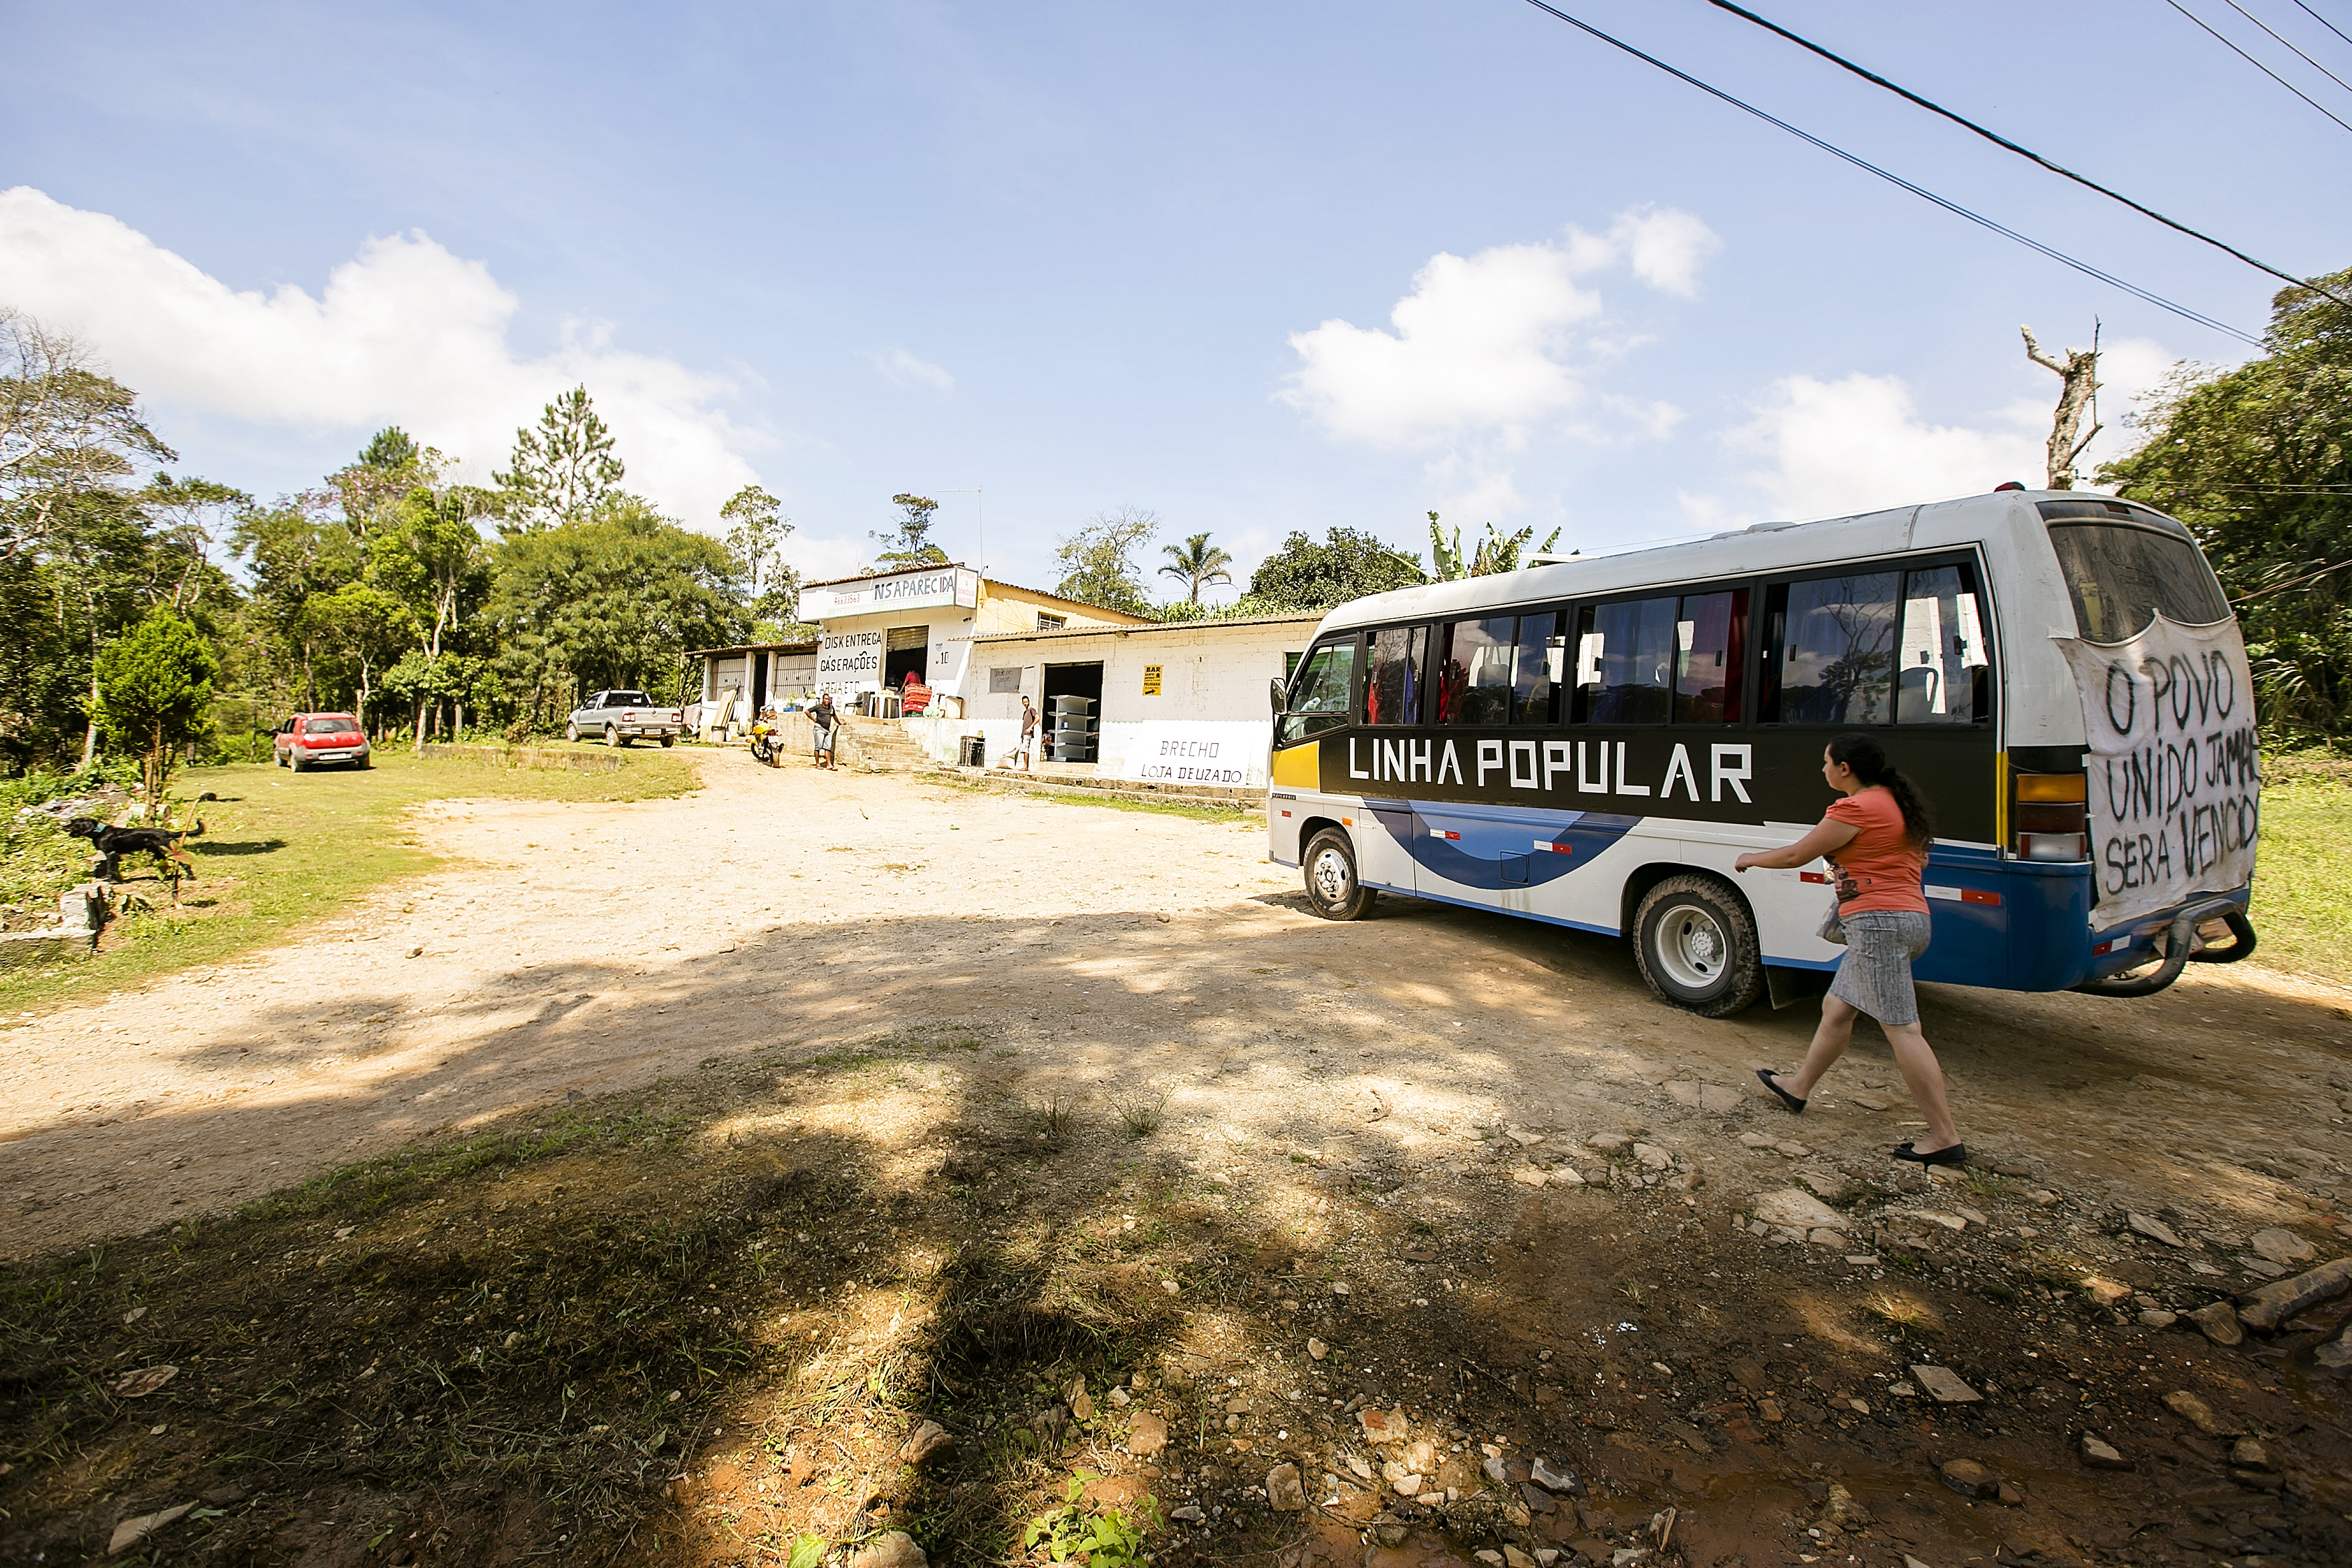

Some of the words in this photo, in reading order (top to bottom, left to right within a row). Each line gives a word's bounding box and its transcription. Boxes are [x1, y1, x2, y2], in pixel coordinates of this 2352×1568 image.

[834, 594, 861, 606] 46633563
[825, 636, 843, 650] DISK
[845, 632, 882, 648] ENTREGA
[941, 651, 948, 664] 10
[2105, 659, 2135, 736] O
[2139, 650, 2234, 733] POVO
[1160, 741, 1219, 758] BRECHO
[1142, 764, 1172, 778] LOJA
[1349, 737, 1464, 785] LINHA
[1477, 739, 1752, 803] POPULAR
